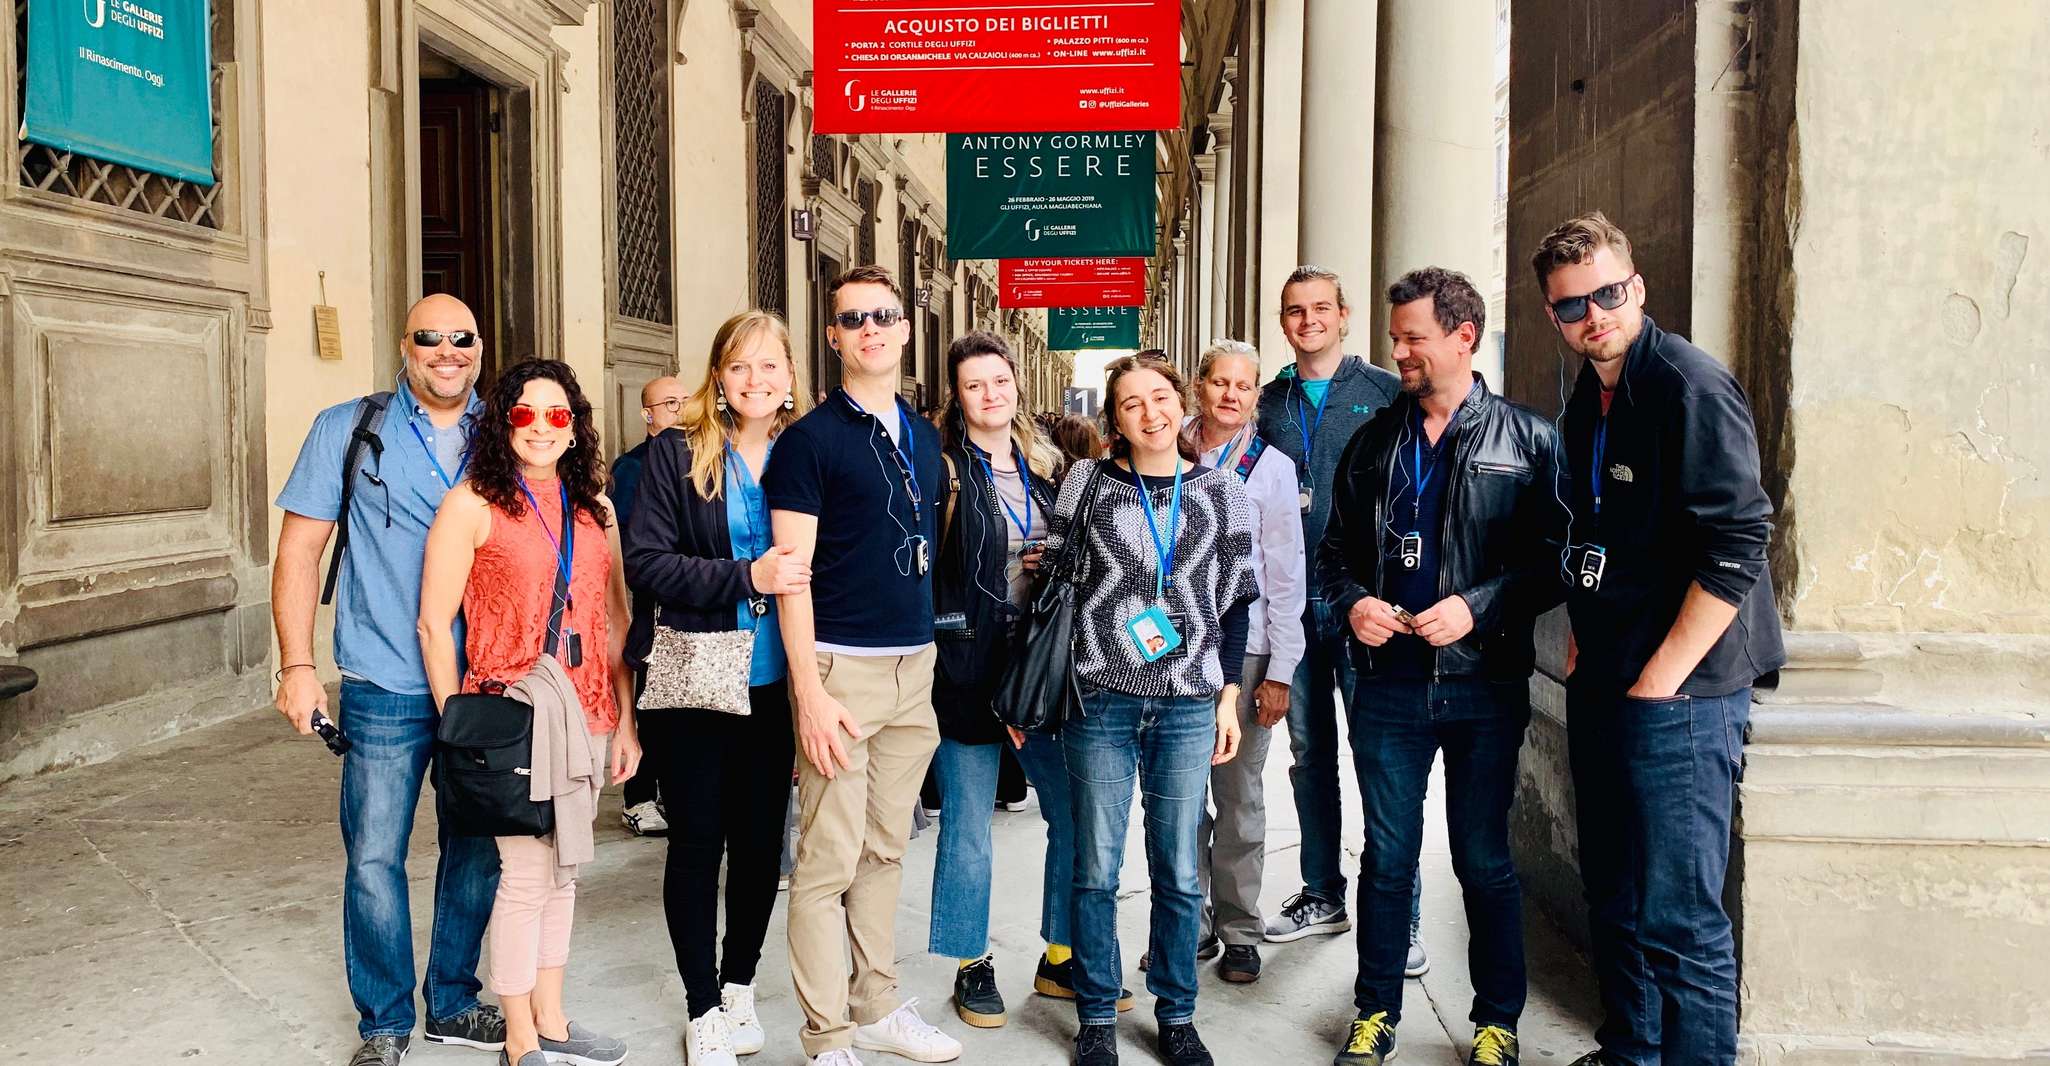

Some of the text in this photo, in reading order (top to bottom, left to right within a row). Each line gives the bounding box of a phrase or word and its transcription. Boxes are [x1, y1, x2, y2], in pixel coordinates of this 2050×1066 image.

[122, 1, 163, 26] GALLERIE
[111, 9, 164, 40] DEGLI UFFIZI
[884, 15, 1108, 36] ACQUISTO DEI BIGLIETTI
[851, 39, 976, 49] PORTA 2 CORTILE DEGLI UFFIZI
[1053, 37, 1092, 45] PALAZZO
[880, 53, 889, 61] DI
[890, 52, 951, 61] ORSANMICHELE
[954, 52, 968, 60] VIA
[968, 51, 1008, 60] CALZAIOLI
[1053, 48, 1147, 58] ON-LINE www.uffizi.it
[79, 46, 165, 88] Il Rinascimento. Oggi.
[1079, 87, 1125, 95] www.uffizi.it
[1099, 101, 1150, 109] @UffiziGalleries
[962, 135, 1146, 150] ANTONY GORMLEY
[976, 155, 1131, 178] ESSERE
[800, 211, 809, 231] 1
[921, 290, 928, 302] 2
[1059, 306, 1128, 316] ESSERE
[1074, 390, 1088, 417] 1
